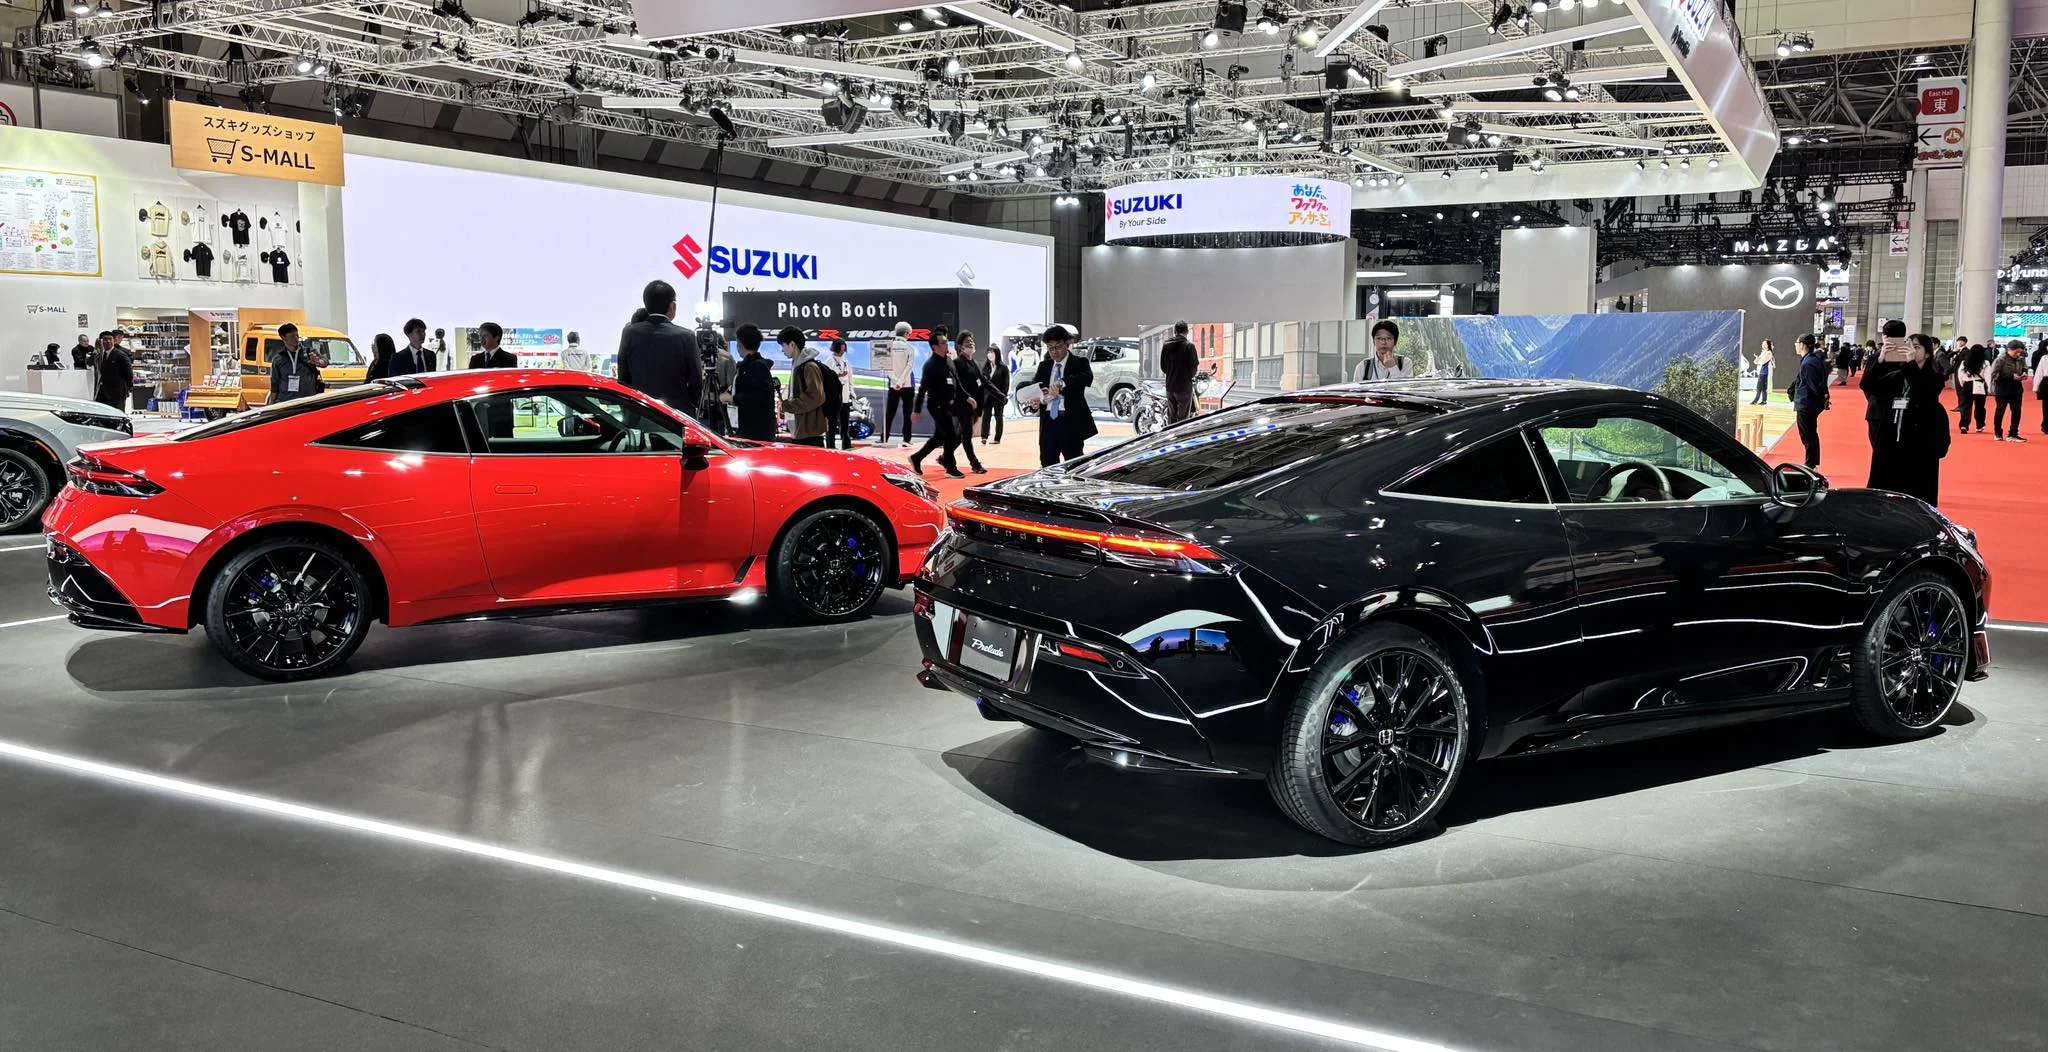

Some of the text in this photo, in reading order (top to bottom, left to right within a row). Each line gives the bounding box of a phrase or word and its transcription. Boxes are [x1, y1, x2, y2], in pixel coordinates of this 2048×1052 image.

[1933, 98, 1948, 112] 東
[204, 116, 315, 142] スズキグッズショップ
[241, 145, 315, 170] S-MALL
[1113, 193, 1183, 216] SUZUKI
[1119, 216, 1166, 229] By Your Side
[1734, 238, 1829, 253] MAZDA
[710, 245, 818, 280] SUZUKI
[777, 302, 898, 318] Photo Booth
[980, 523, 1044, 544] Honda
[971, 638, 1004, 657] Prelude
